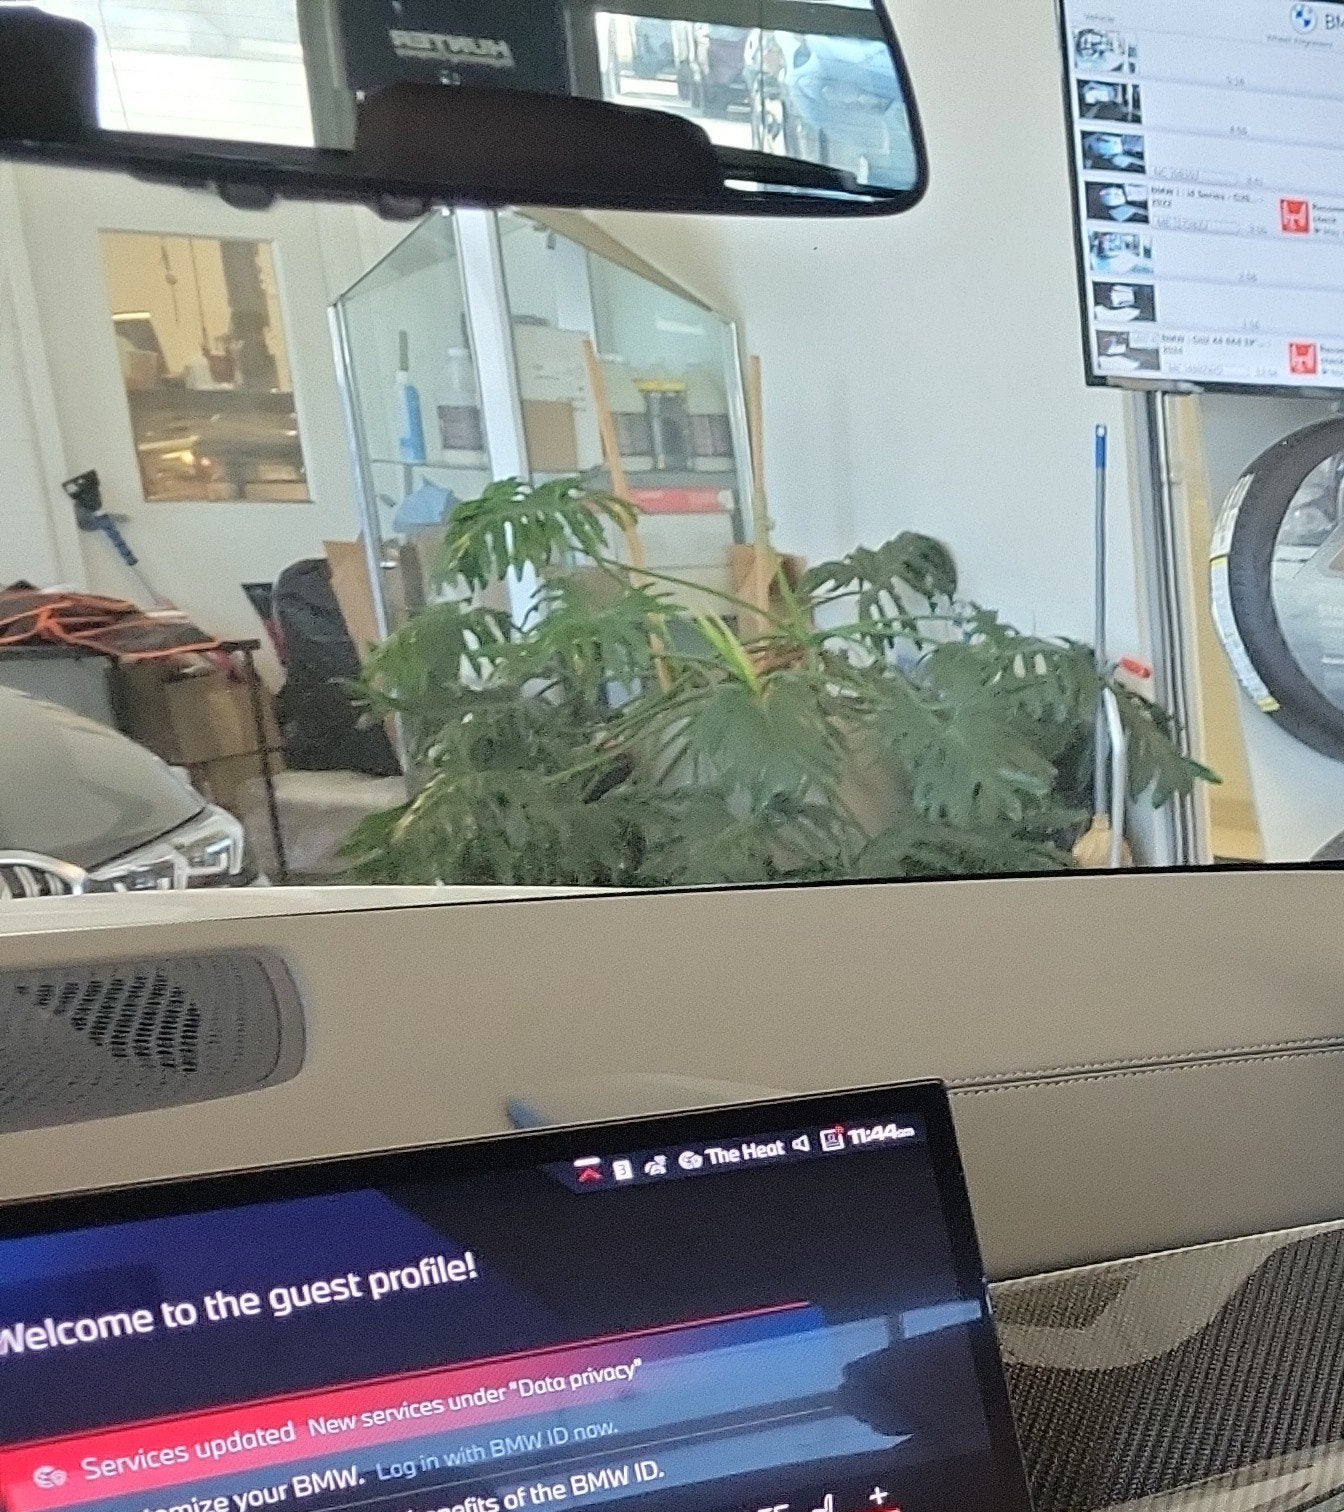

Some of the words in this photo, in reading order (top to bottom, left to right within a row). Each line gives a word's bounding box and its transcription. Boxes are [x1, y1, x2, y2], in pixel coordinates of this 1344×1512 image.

[705, 1147, 740, 1165] The
[742, 1140, 786, 1161] Heat
[0, 1306, 154, 1355] Welcome
[162, 1299, 197, 1329] to
[204, 1290, 261, 1320] the
[269, 1272, 363, 1317] guest
[369, 1251, 478, 1300] profile!
[81, 1444, 189, 1480] Services
[194, 1421, 296, 1461] updated
[308, 1413, 357, 1437] New
[361, 1400, 445, 1428] services
[448, 1385, 507, 1411] under
[376, 1460, 417, 1481] Log
[420, 1455, 439, 1473] in
[443, 1445, 485, 1468] with
[490, 1432, 543, 1459] BMW
[548, 1426, 569, 1447] ID
[574, 1420, 619, 1442] now.
[292, 1466, 366, 1500] BMW.
[503, 1487, 528, 1511] of
[530, 1481, 567, 1504] the
[570, 1464, 630, 1497] BMW
[636, 1460, 666, 1483] ID.
